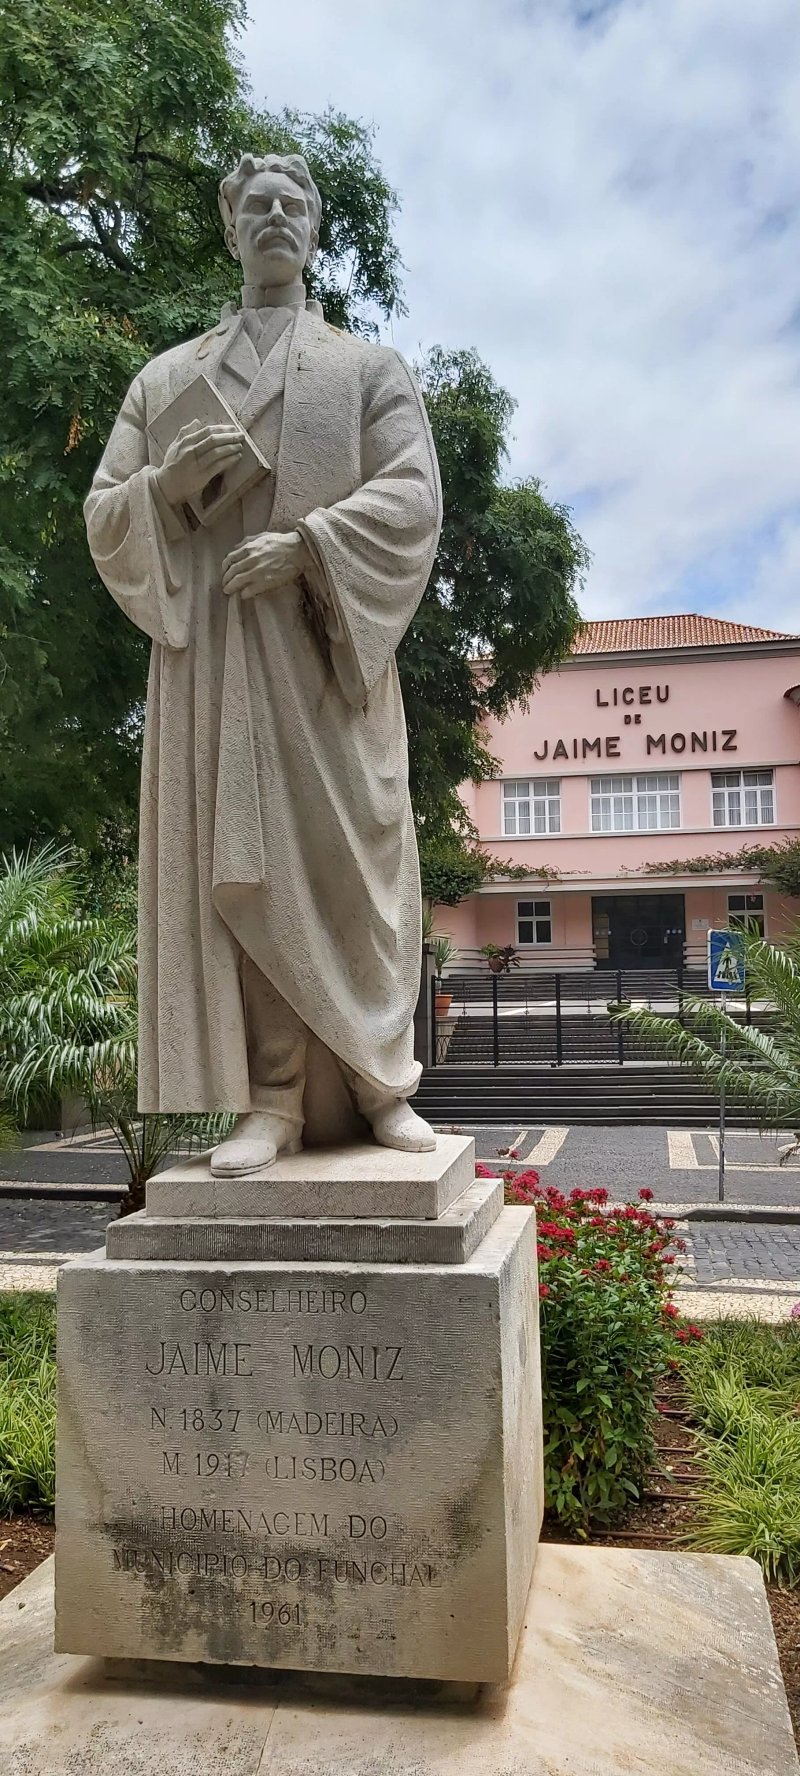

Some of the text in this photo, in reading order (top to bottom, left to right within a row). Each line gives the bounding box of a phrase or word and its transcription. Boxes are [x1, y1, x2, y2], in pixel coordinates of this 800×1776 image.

[596, 685, 670, 707] LICEU
[624, 714, 642, 725] DE
[533, 729, 738, 761] JAIME MONIZ
[179, 1289, 368, 1315] CONSELHEIRO
[144, 1341, 405, 1381] JAIME MONIZ
[256, 1409, 400, 1438] (MADEIRA)
[265, 1455, 386, 1484] (LISBOA)
[160, 1506, 388, 1540] HOMENAGEM DO
[111, 1547, 443, 1588] MUNICIPIO DO FUNCHAL
[248, 1601, 302, 1627] 1961
